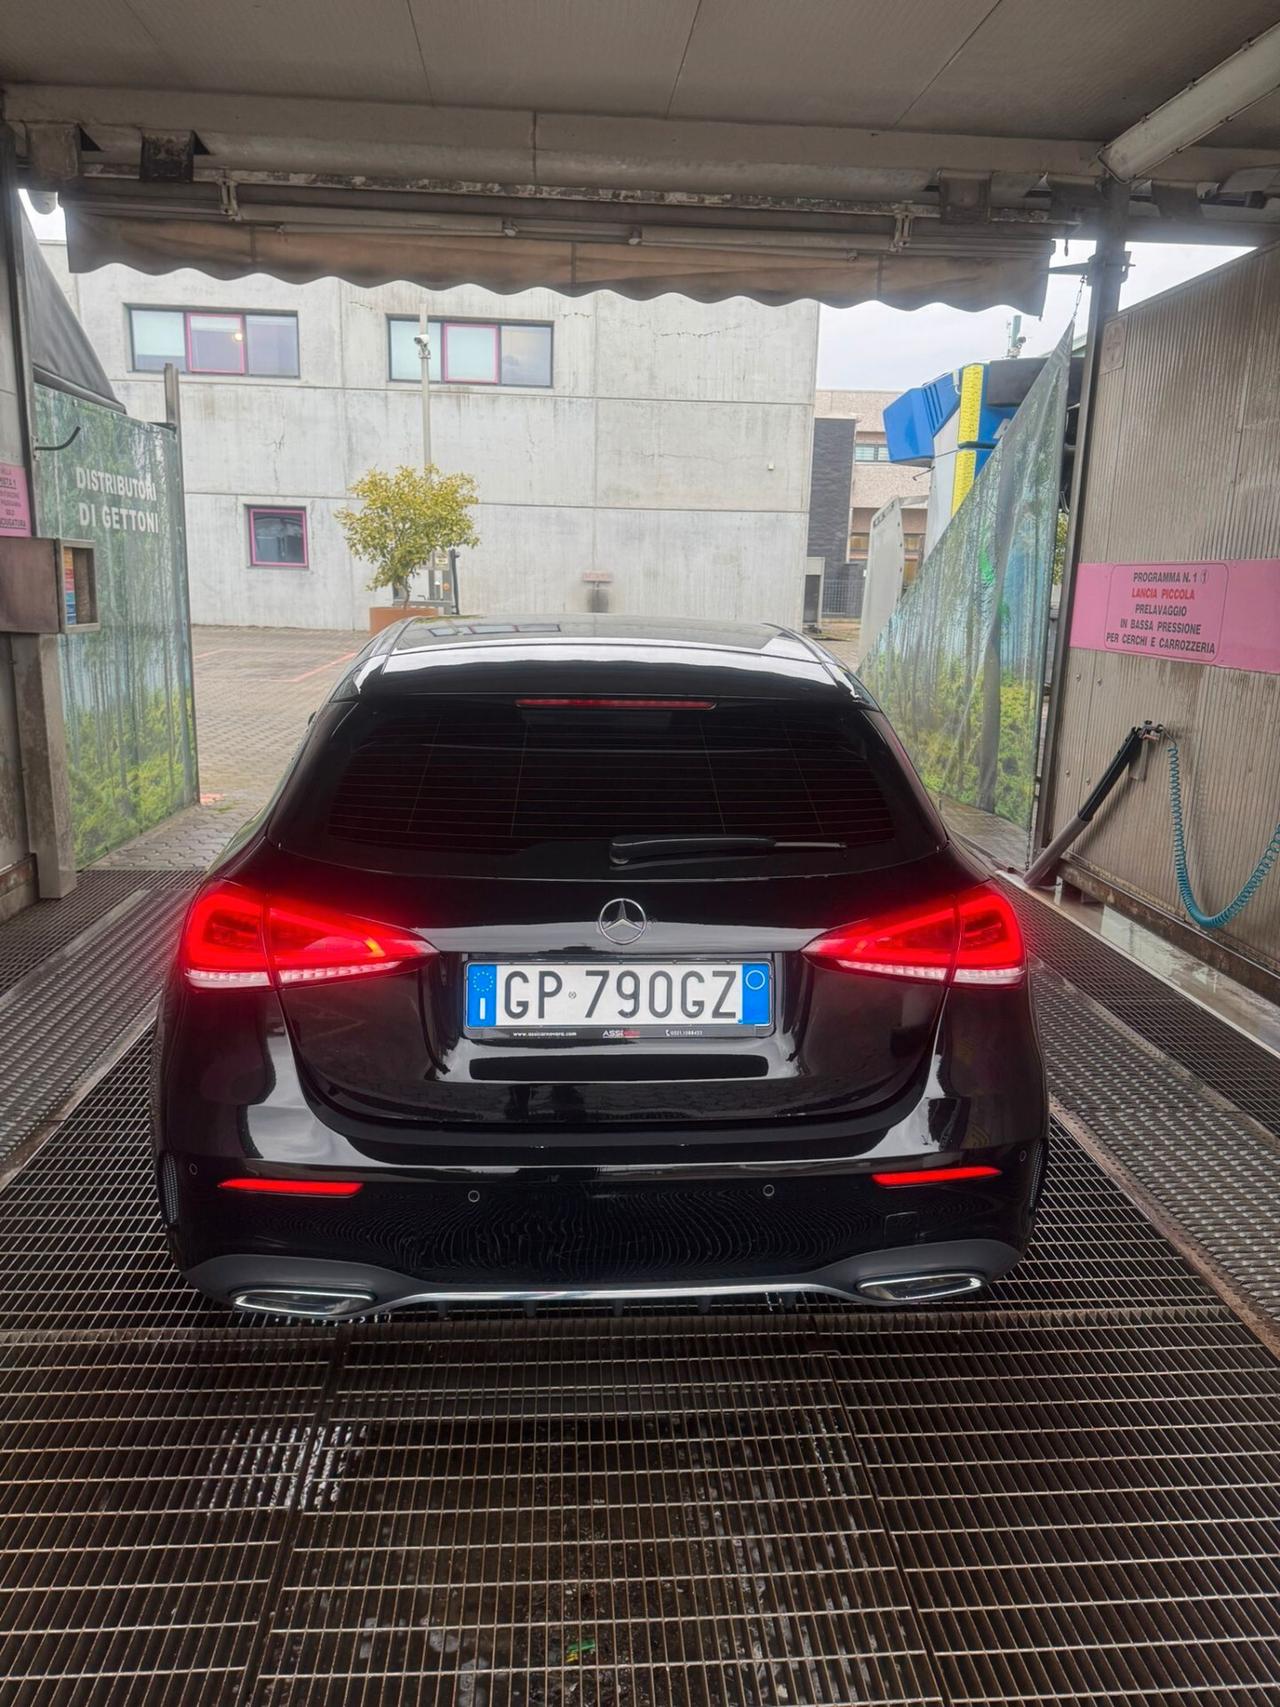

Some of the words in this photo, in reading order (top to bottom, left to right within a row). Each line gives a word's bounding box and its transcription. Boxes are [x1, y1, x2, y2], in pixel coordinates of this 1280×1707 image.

[75, 467, 157, 501] DISTRIBUTORI
[79, 502, 97, 527] DI
[102, 505, 159, 533] GETTONI
[1133, 572, 1181, 583] PROGRAMMA
[1182, 572, 1191, 583] N.
[1192, 572, 1198, 582] 1
[1132, 588, 1157, 599] LANCIA
[1161, 588, 1195, 600] PICCOLA
[1135, 604, 1187, 617] PRELAVAGGIO
[1120, 619, 1128, 629] IN
[1130, 619, 1154, 631] BASSA
[1157, 621, 1201, 635] PRESSIONE
[1106, 632, 1119, 643] PER
[1122, 633, 1148, 646] CERCHI
[1150, 637, 1156, 647] E
[1159, 638, 1216, 654] CARROZZERIA
